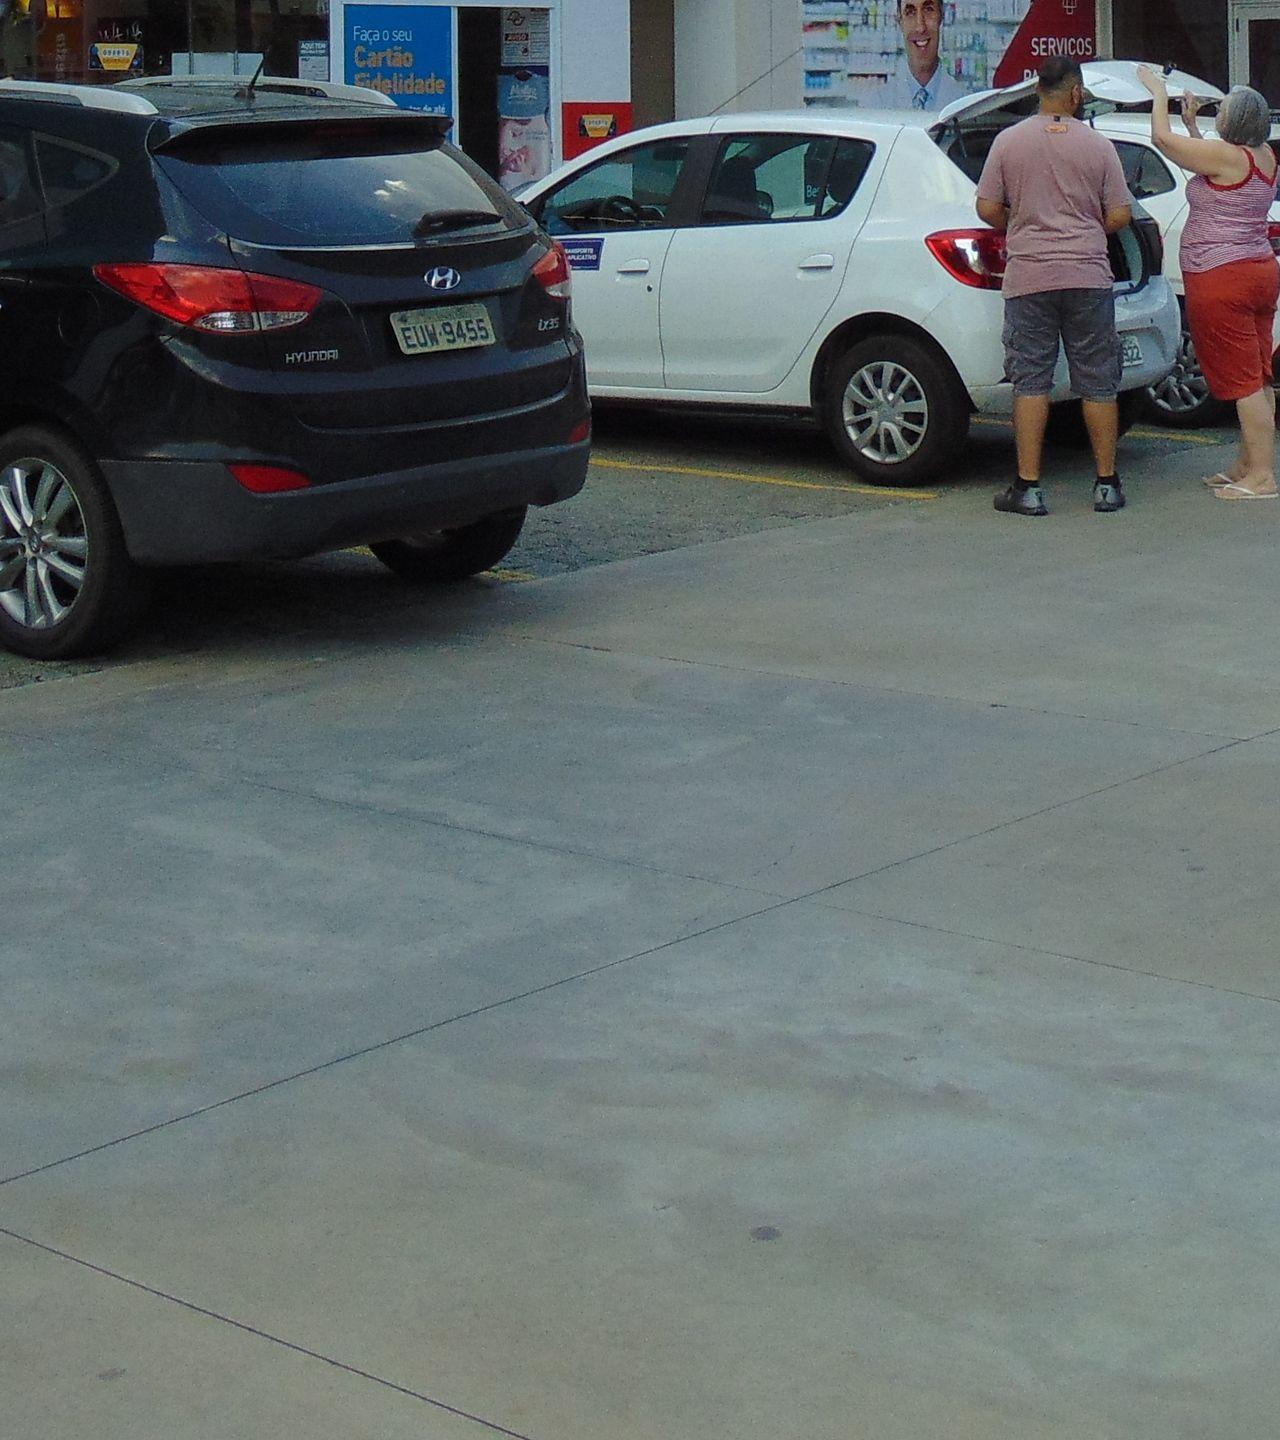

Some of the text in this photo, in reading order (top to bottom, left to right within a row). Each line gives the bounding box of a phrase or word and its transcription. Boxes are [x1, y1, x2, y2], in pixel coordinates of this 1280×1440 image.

[353, 25, 413, 45] Faça o seu
[354, 45, 413, 68] Cartão
[354, 72, 446, 95] Fidelidade
[538, 317, 560, 331] ix35
[285, 349, 339, 364] HYUNDAI
